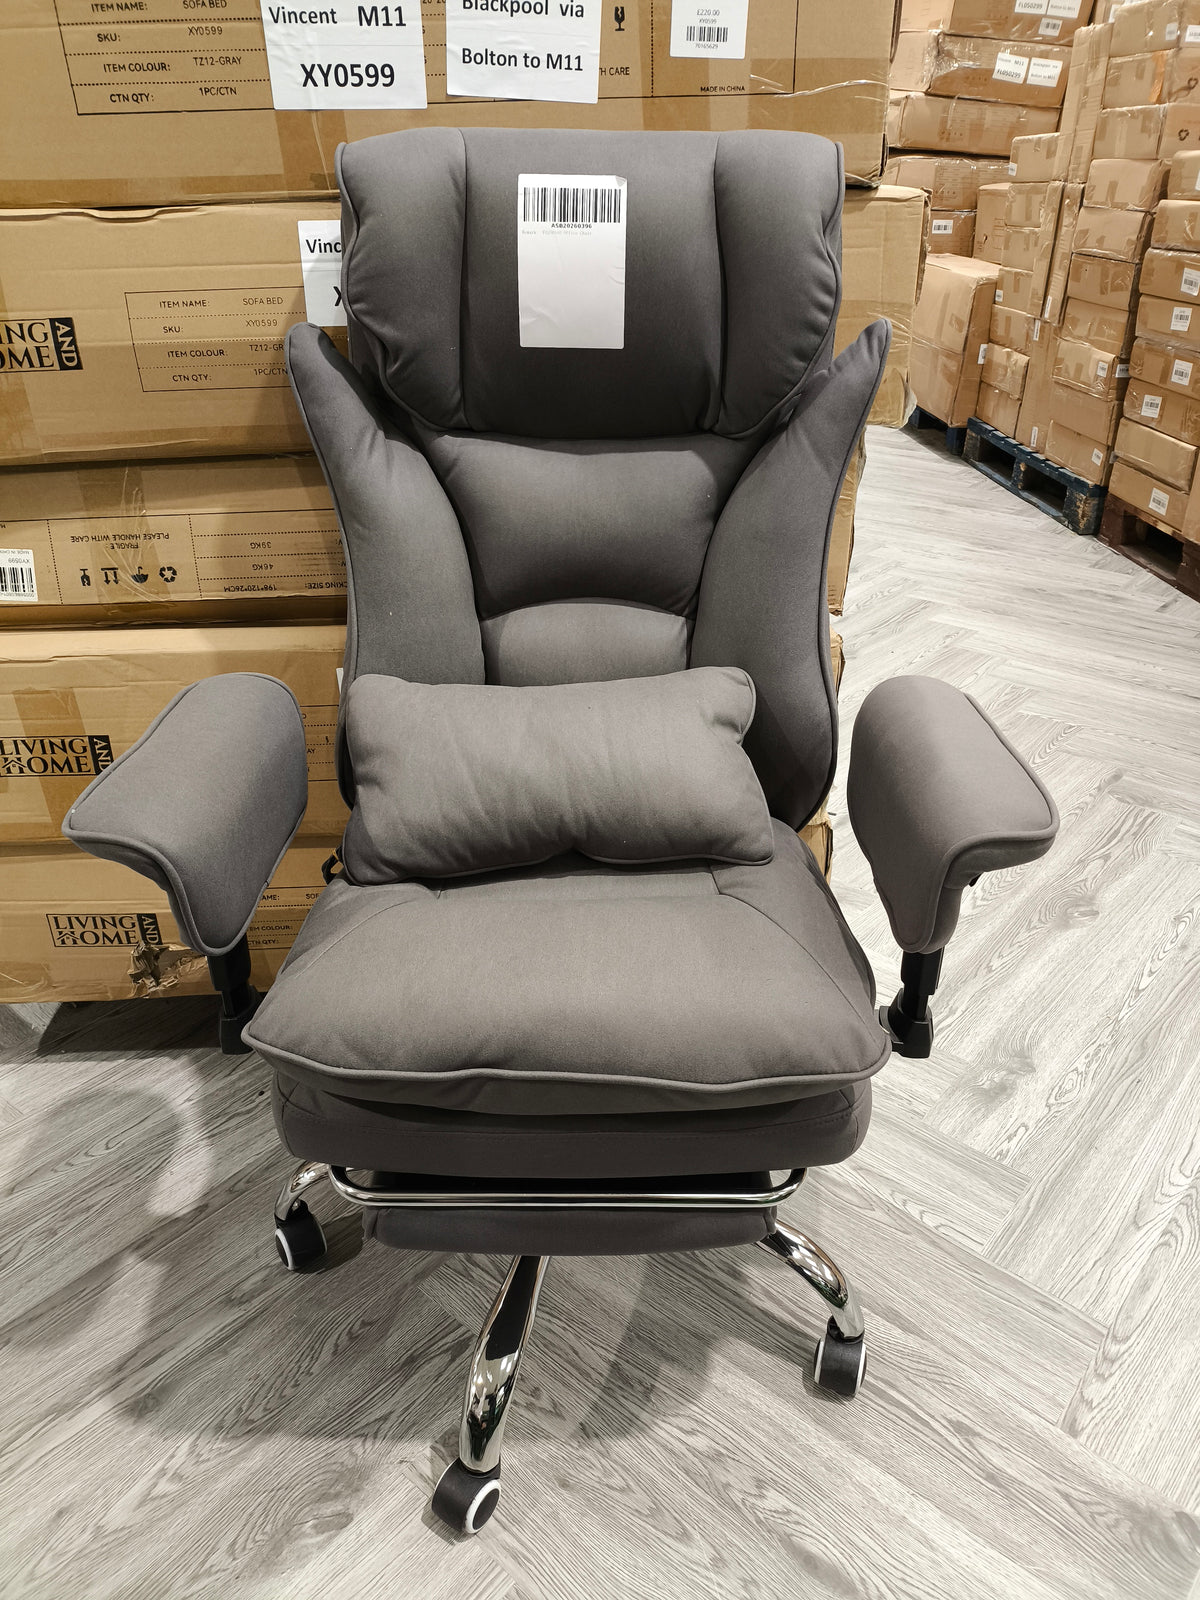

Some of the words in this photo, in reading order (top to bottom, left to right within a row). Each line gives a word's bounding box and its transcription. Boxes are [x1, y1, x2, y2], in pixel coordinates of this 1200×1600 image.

[91, 3, 114, 12] ITEM
[116, 2, 148, 11] NAME:
[183, 0, 207, 9] SOFA
[209, 0, 227, 8] BED
[463, 0, 548, 17] Blackpool
[560, 0, 584, 17] via
[268, 6, 337, 24] Vincent
[357, 5, 406, 27] M11
[97, 33, 121, 42] SKU:
[188, 26, 223, 36] XY0599
[103, 63, 126, 73] ITEM
[128, 62, 171, 72] COLOUR:
[193, 56, 242, 66] TZ12-GRAY
[462, 48, 517, 67] Bolton
[523, 52, 540, 69] to
[546, 53, 583, 71] M11
[300, 63, 395, 87] XY0599
[609, 67, 630, 76] CARE
[109, 94, 130, 103] CTN
[131, 93, 154, 104] QTY:
[199, 87, 237, 96] 1PC/CTN
[305, 239, 342, 253] Vinc
[266, 297, 283, 305] BED
[245, 319, 278, 327] XY0599
[55, 321, 78, 367] AND
[167, 350, 188, 358] ITEM
[190, 349, 228, 357] COLOUR:
[249, 344, 284, 352] TZ12-GR
[172, 374, 189, 382] CTN
[191, 373, 212, 382] QTY:
[70, 535, 90, 543] CARE
[91, 534, 110, 542] WITH
[143, 533, 170, 541] PLEASE
[250, 541, 272, 549] 39KG
[252, 563, 274, 571] 46KG
[325, 581, 348, 589] CKING
[0, 738, 88, 755] LIVING
[2, 756, 91, 774] HOME
[53, 915, 137, 929] LIVING
[142, 915, 159, 943] AND
[57, 930, 139, 945] HOME
